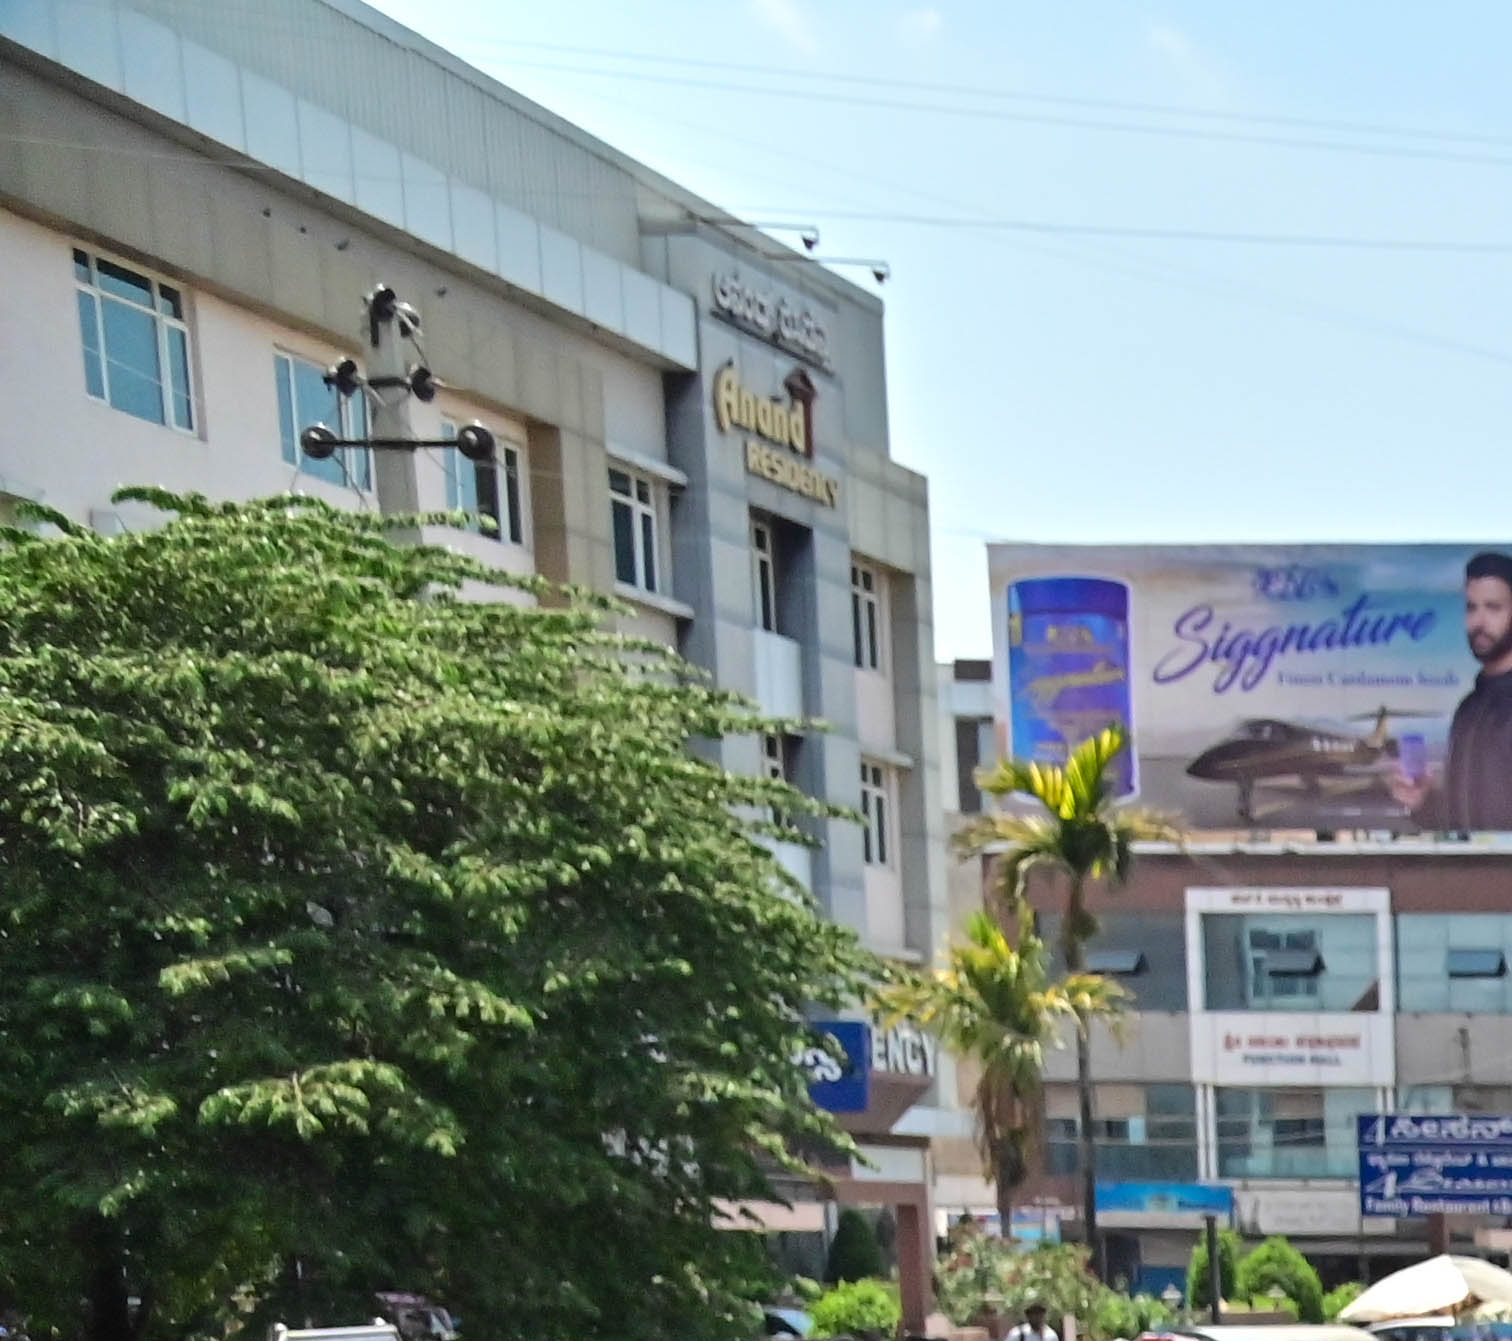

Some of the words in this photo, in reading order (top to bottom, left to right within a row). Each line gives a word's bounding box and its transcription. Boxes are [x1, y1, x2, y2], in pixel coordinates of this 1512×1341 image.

[713, 357, 813, 458] Anand
[745, 440, 838, 510] RESIDENCY
[1153, 594, 1435, 694] Siggnature
